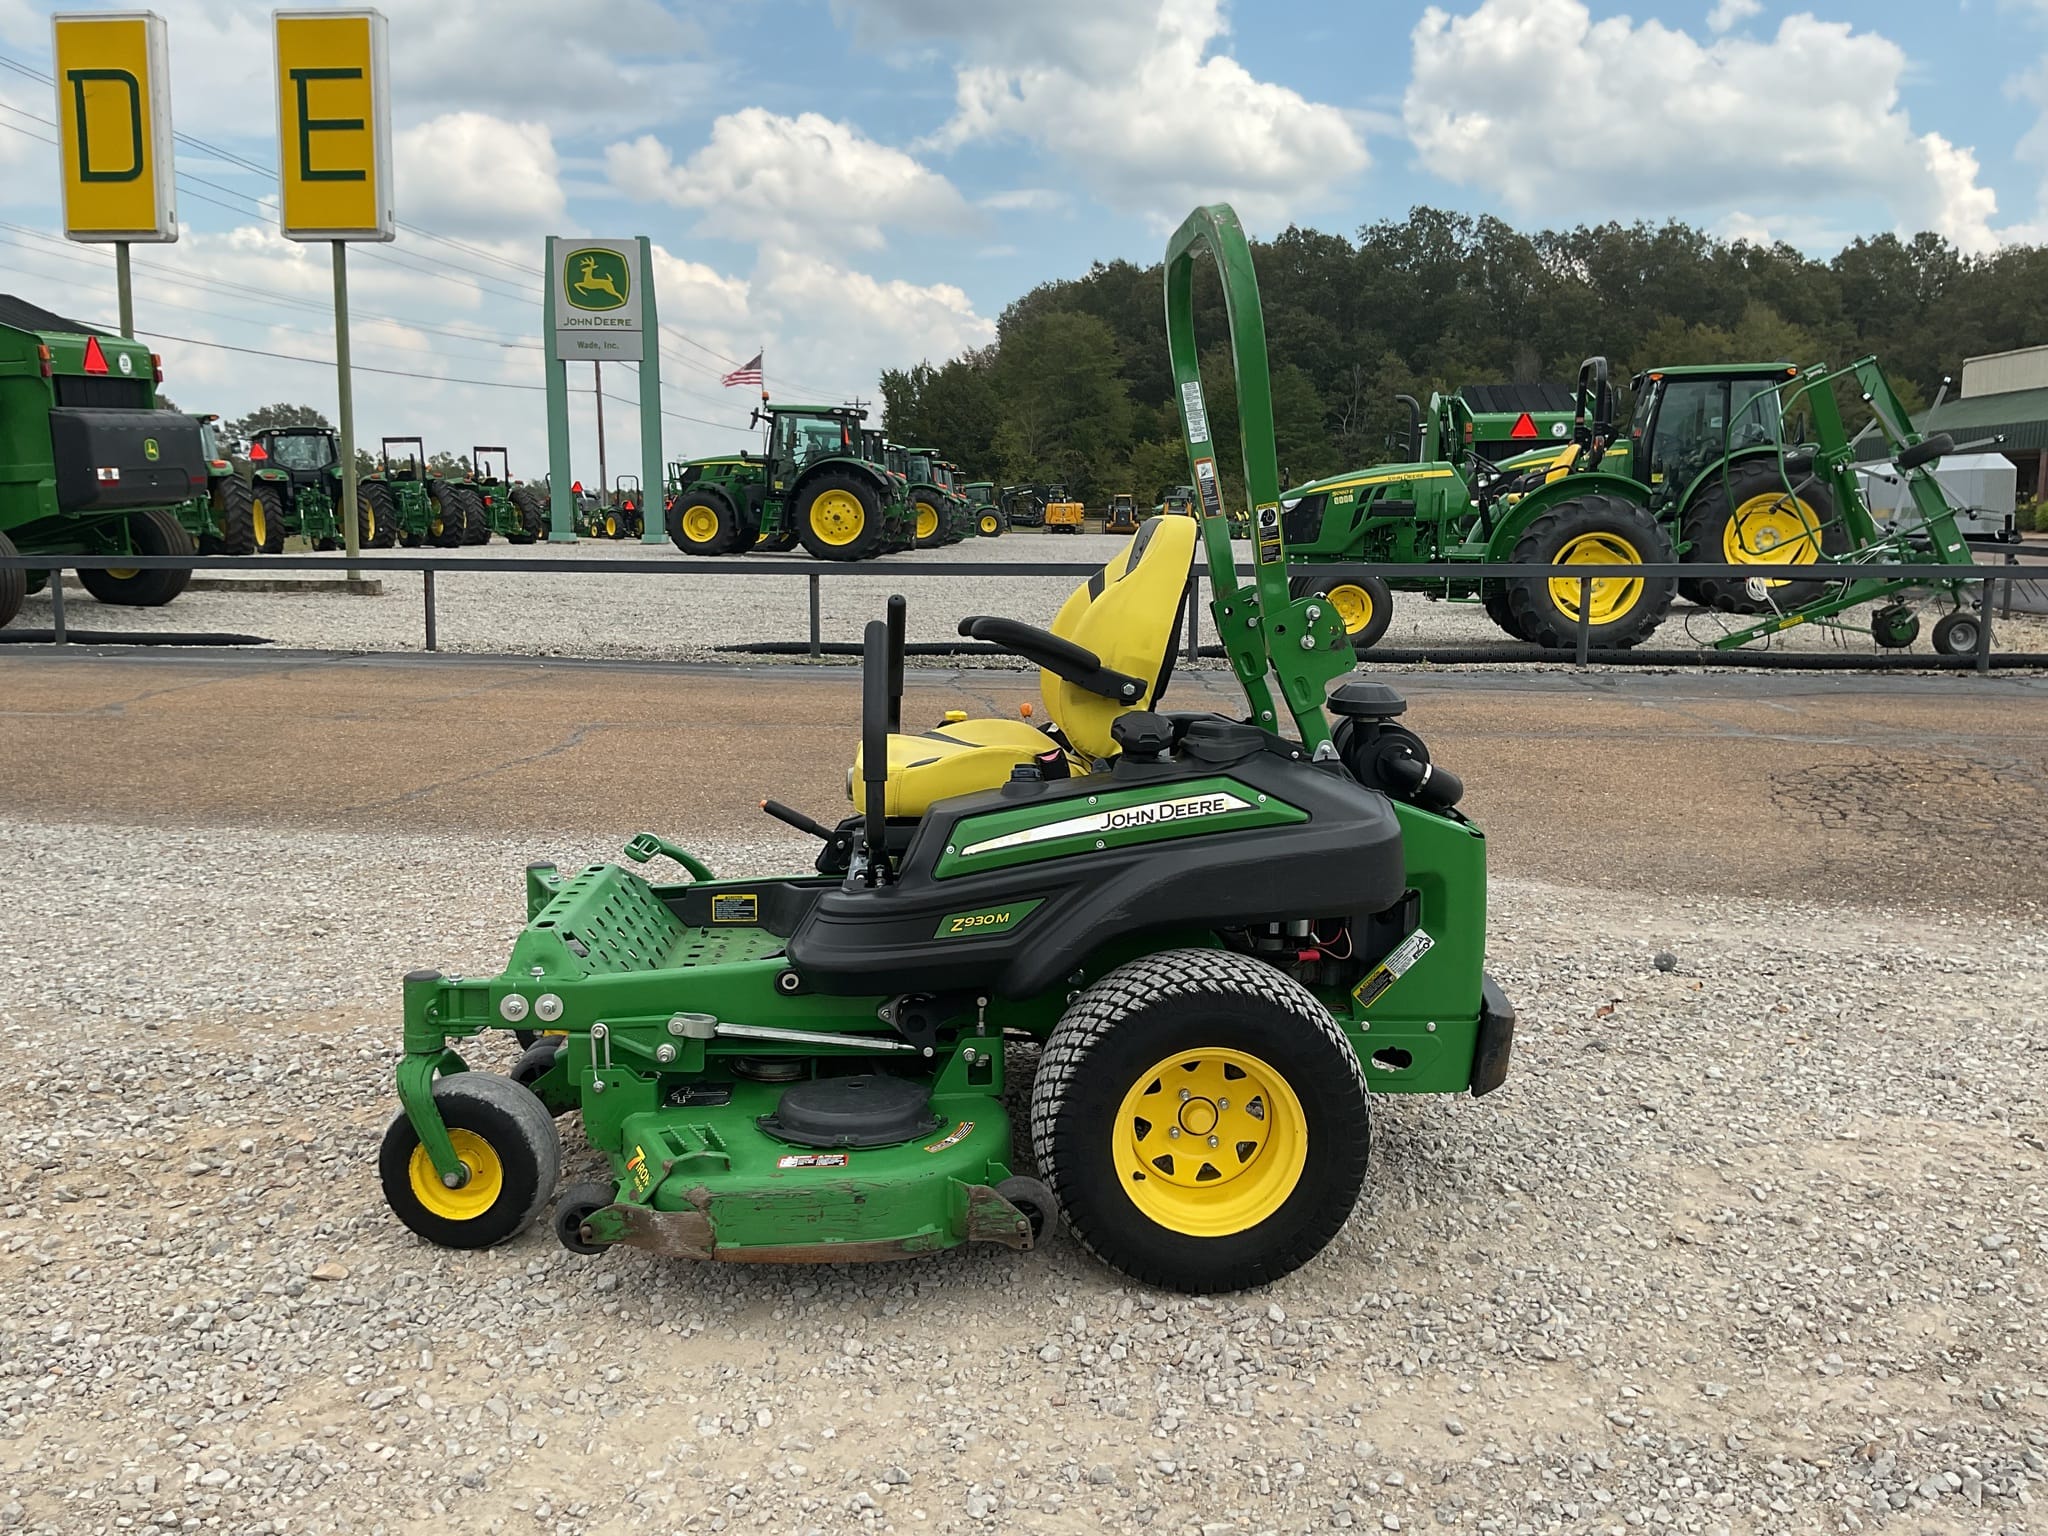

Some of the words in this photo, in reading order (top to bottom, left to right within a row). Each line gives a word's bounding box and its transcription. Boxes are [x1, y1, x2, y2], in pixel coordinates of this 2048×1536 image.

[67, 69, 143, 182] D
[289, 68, 366, 181] E
[563, 316, 593, 327] JOHN
[594, 316, 632, 327] DEERE
[576, 341, 601, 350] Wade,
[603, 341, 620, 350] Inc.
[1100, 805, 1155, 830] JOHN
[1159, 798, 1225, 820] DEERE
[950, 912, 1010, 933] Z930M
